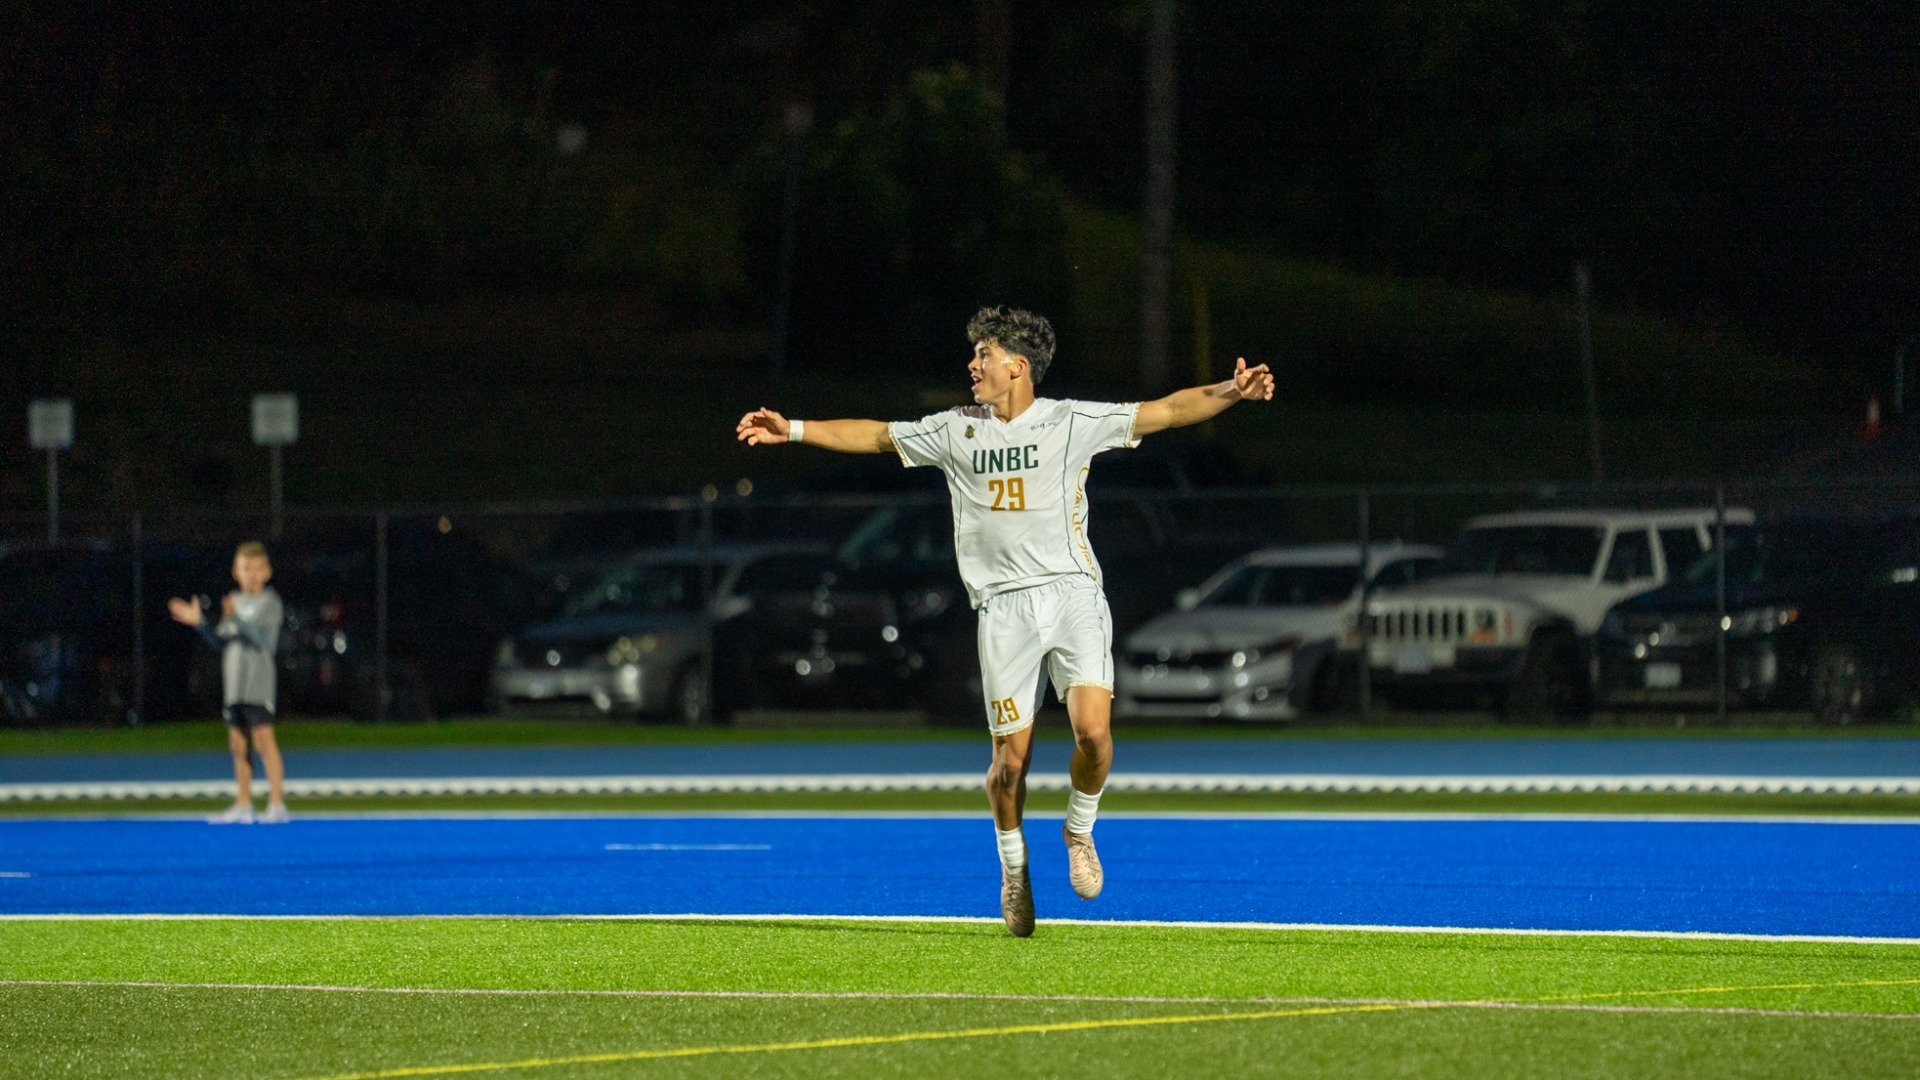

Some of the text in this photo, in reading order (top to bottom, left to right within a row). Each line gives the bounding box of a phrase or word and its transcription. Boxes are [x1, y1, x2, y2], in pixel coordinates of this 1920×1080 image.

[973, 444, 1038, 474] UNBC
[988, 477, 1025, 511] 29
[991, 697, 1020, 726] 29
